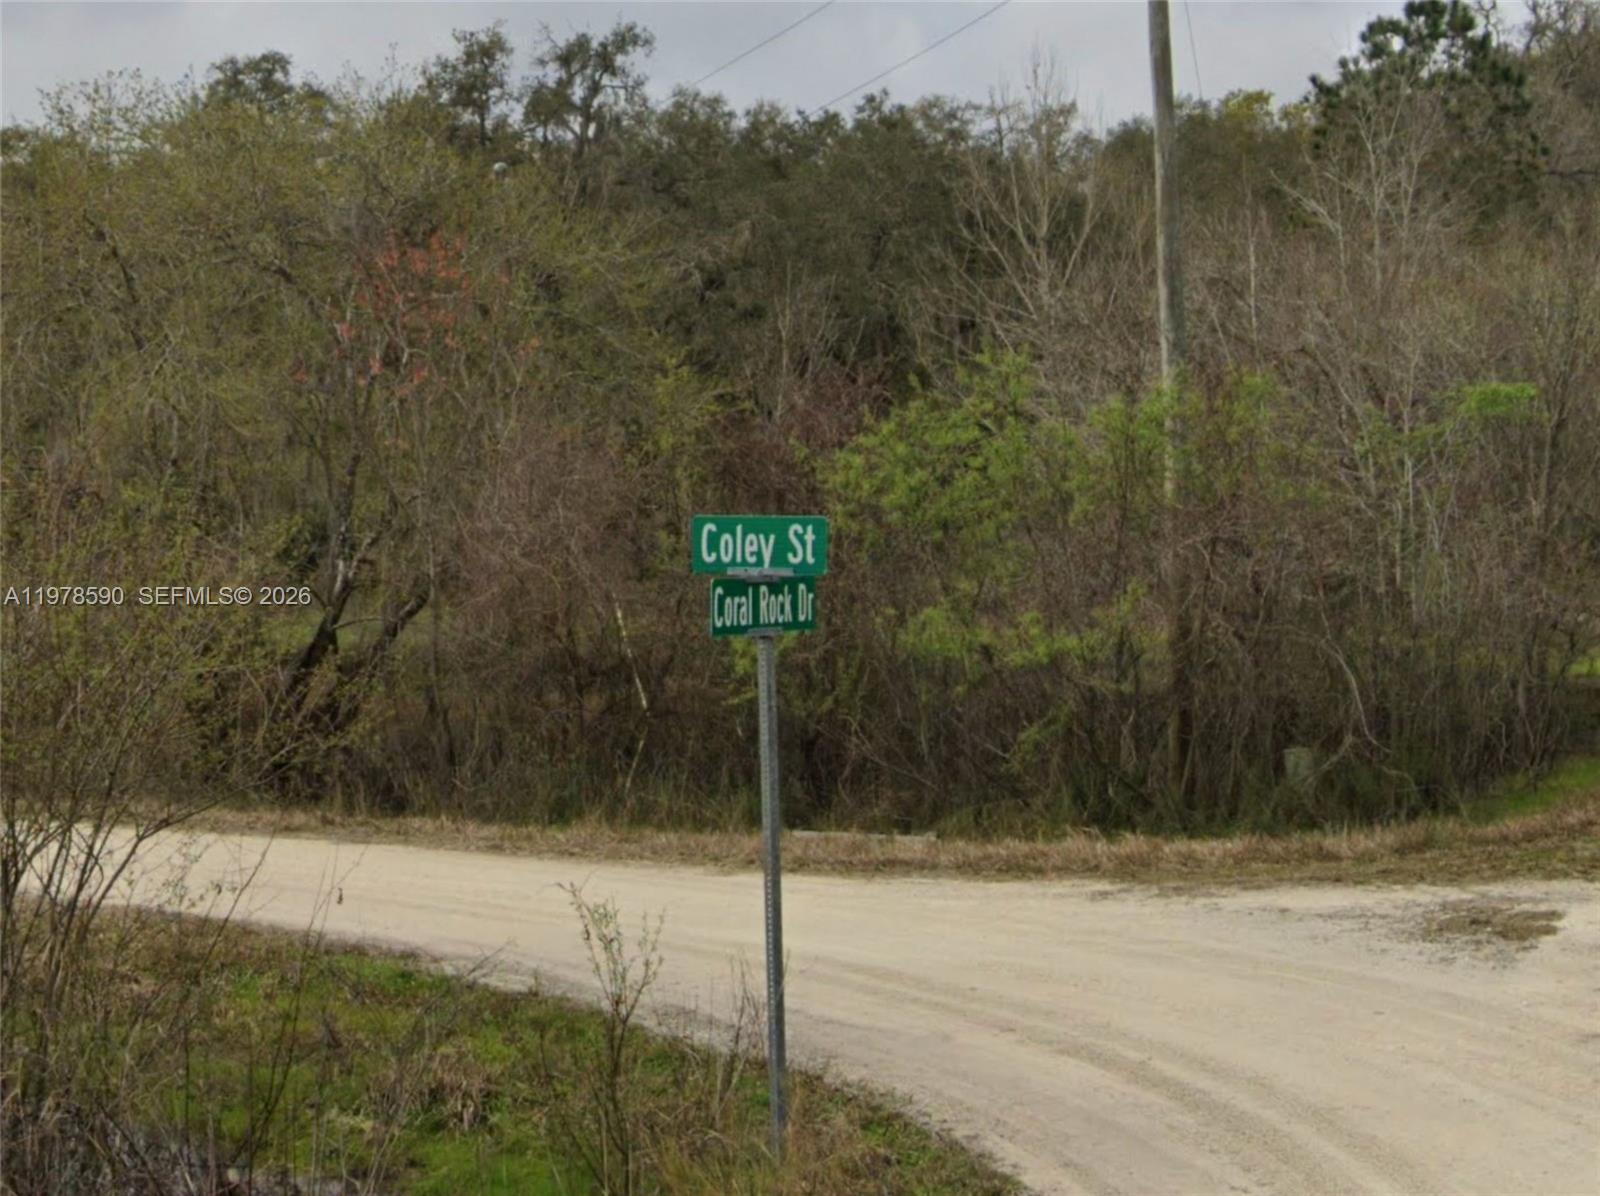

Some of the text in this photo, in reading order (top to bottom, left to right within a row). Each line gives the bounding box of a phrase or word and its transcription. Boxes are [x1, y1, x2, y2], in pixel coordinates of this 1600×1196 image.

[701, 522, 815, 568] Coley St
[714, 583, 814, 628] Coral Rock Dr
